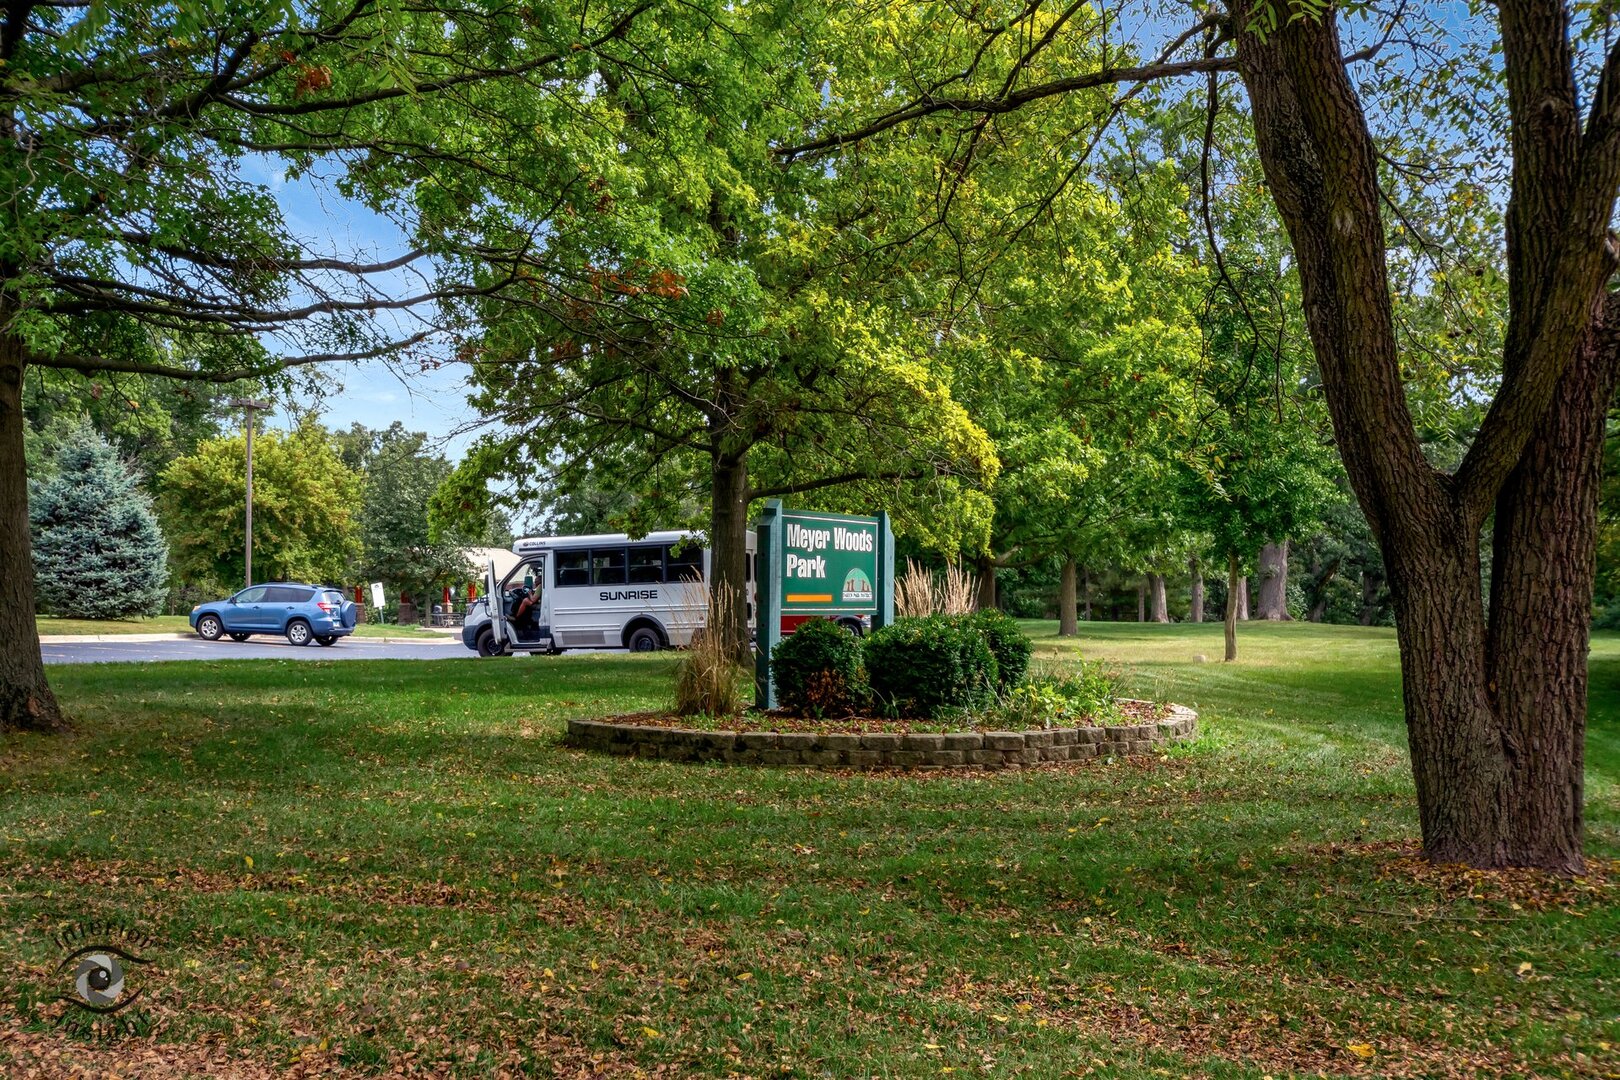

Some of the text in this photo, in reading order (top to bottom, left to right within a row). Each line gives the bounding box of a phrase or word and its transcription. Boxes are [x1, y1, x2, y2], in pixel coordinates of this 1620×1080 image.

[786, 524, 873, 552] Meyer Woods
[786, 554, 826, 578] Park
[600, 590, 658, 601] SUNRISE
